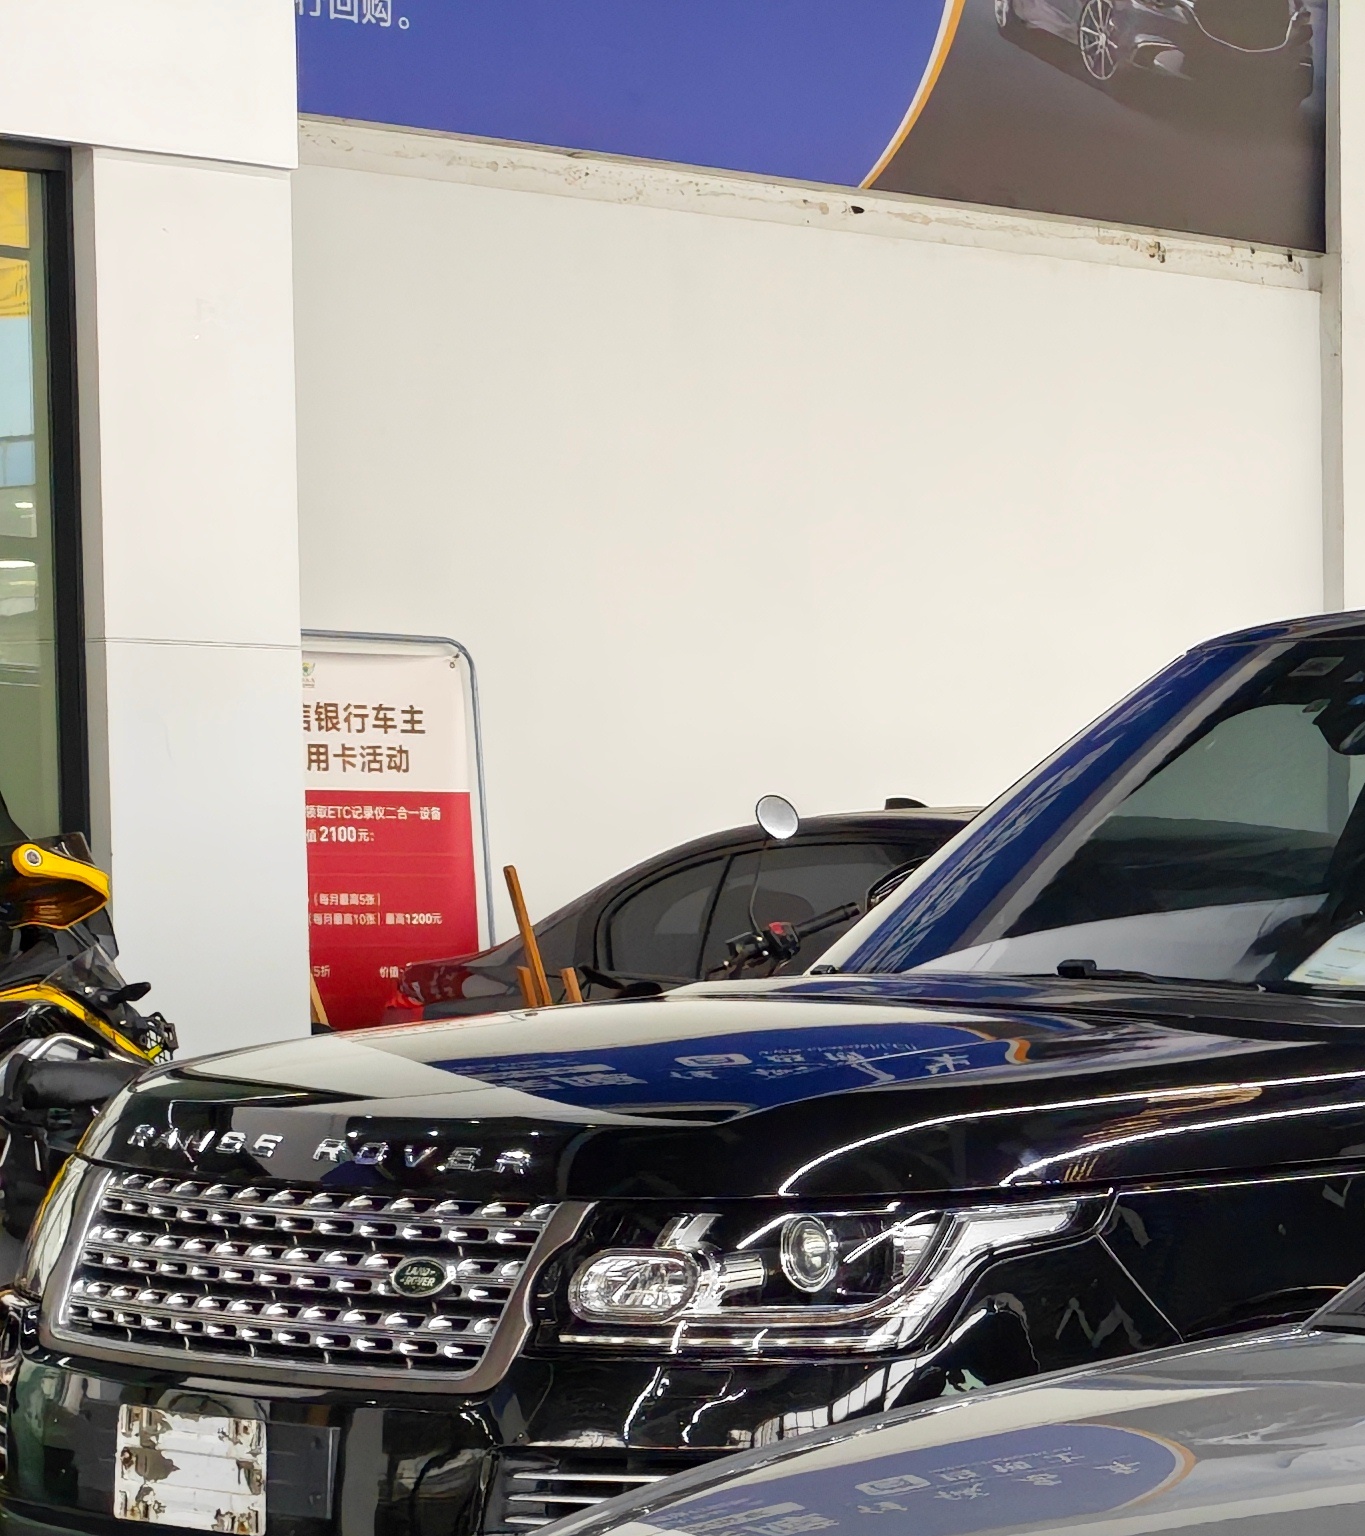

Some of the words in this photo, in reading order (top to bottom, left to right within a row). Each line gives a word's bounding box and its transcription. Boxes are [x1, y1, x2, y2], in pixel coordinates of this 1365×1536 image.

[307, 743, 409, 773] 用卡活动
[312, 1137, 531, 1175] ROVER
